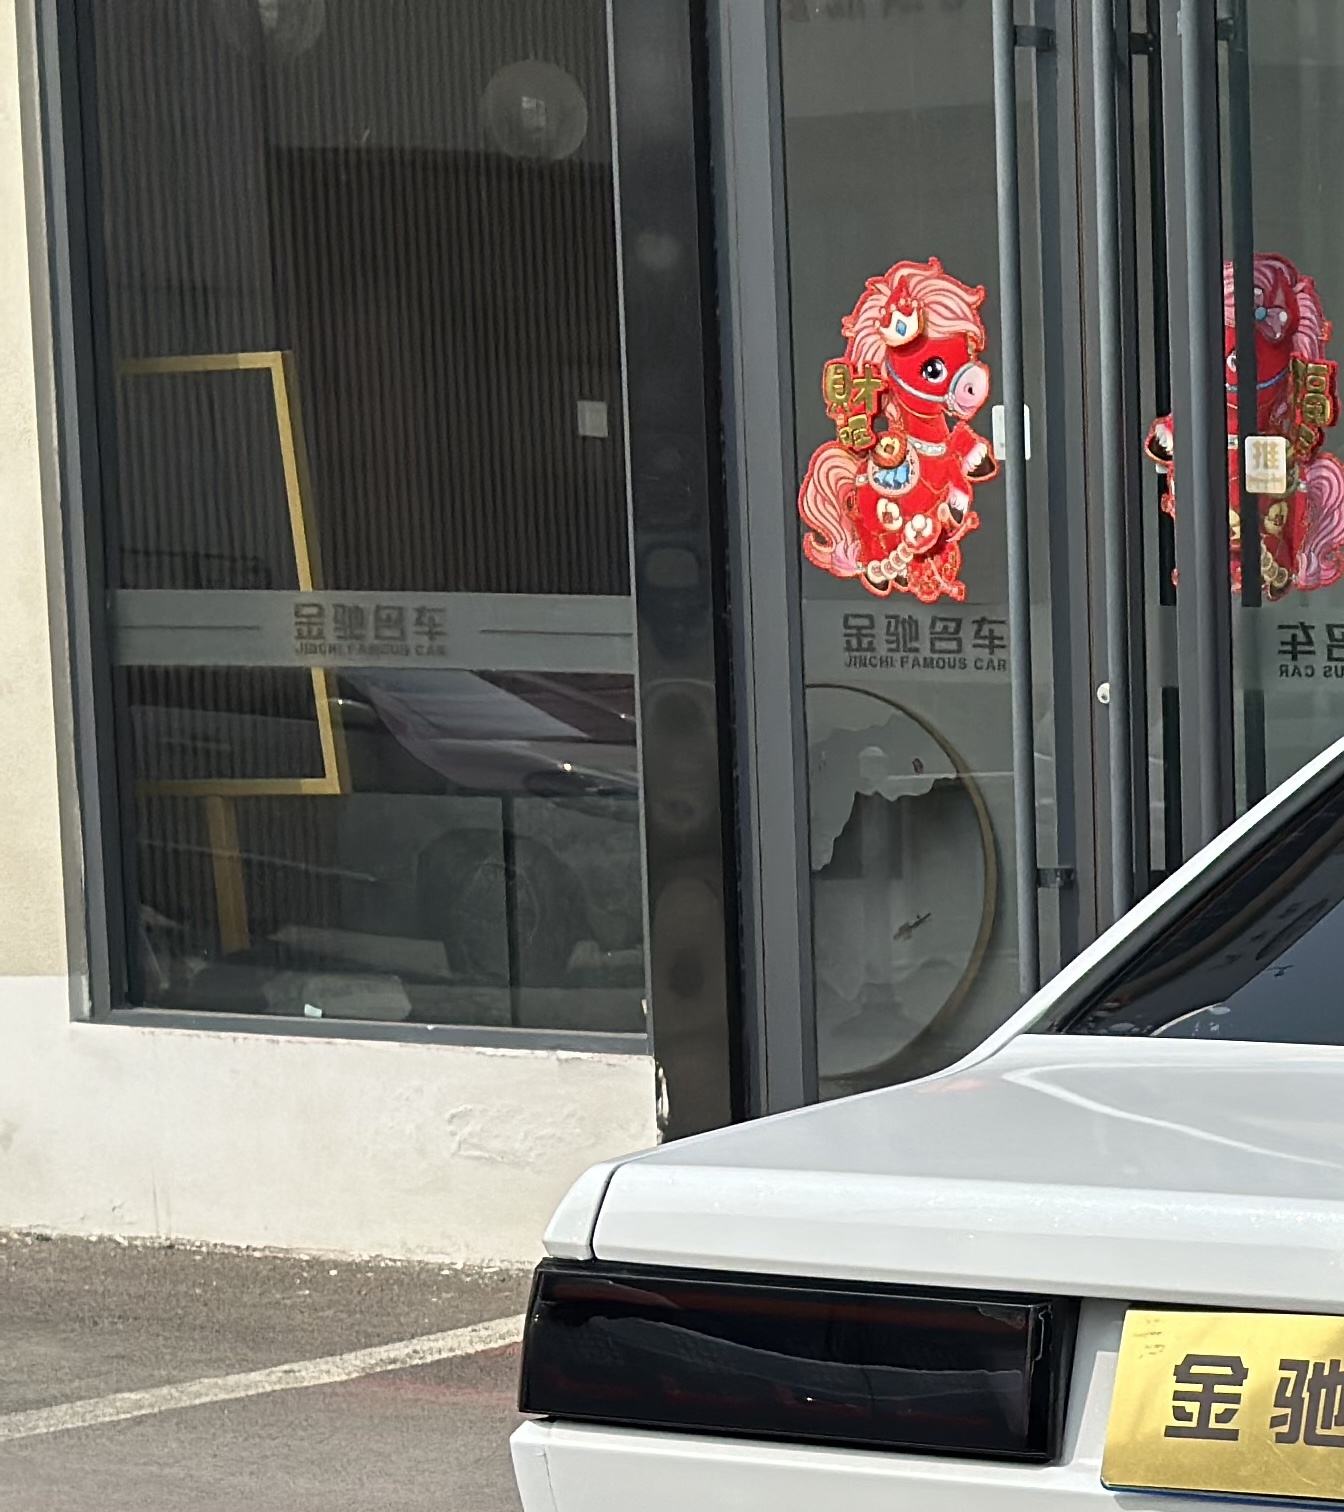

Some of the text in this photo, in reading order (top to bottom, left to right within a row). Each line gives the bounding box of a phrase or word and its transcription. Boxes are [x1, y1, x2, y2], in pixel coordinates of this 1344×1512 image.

[1252, 440, 1279, 470] 推
[842, 613, 1007, 655] 金驰名车
[844, 654, 1007, 672] JINCHI FAMOUS CAR
